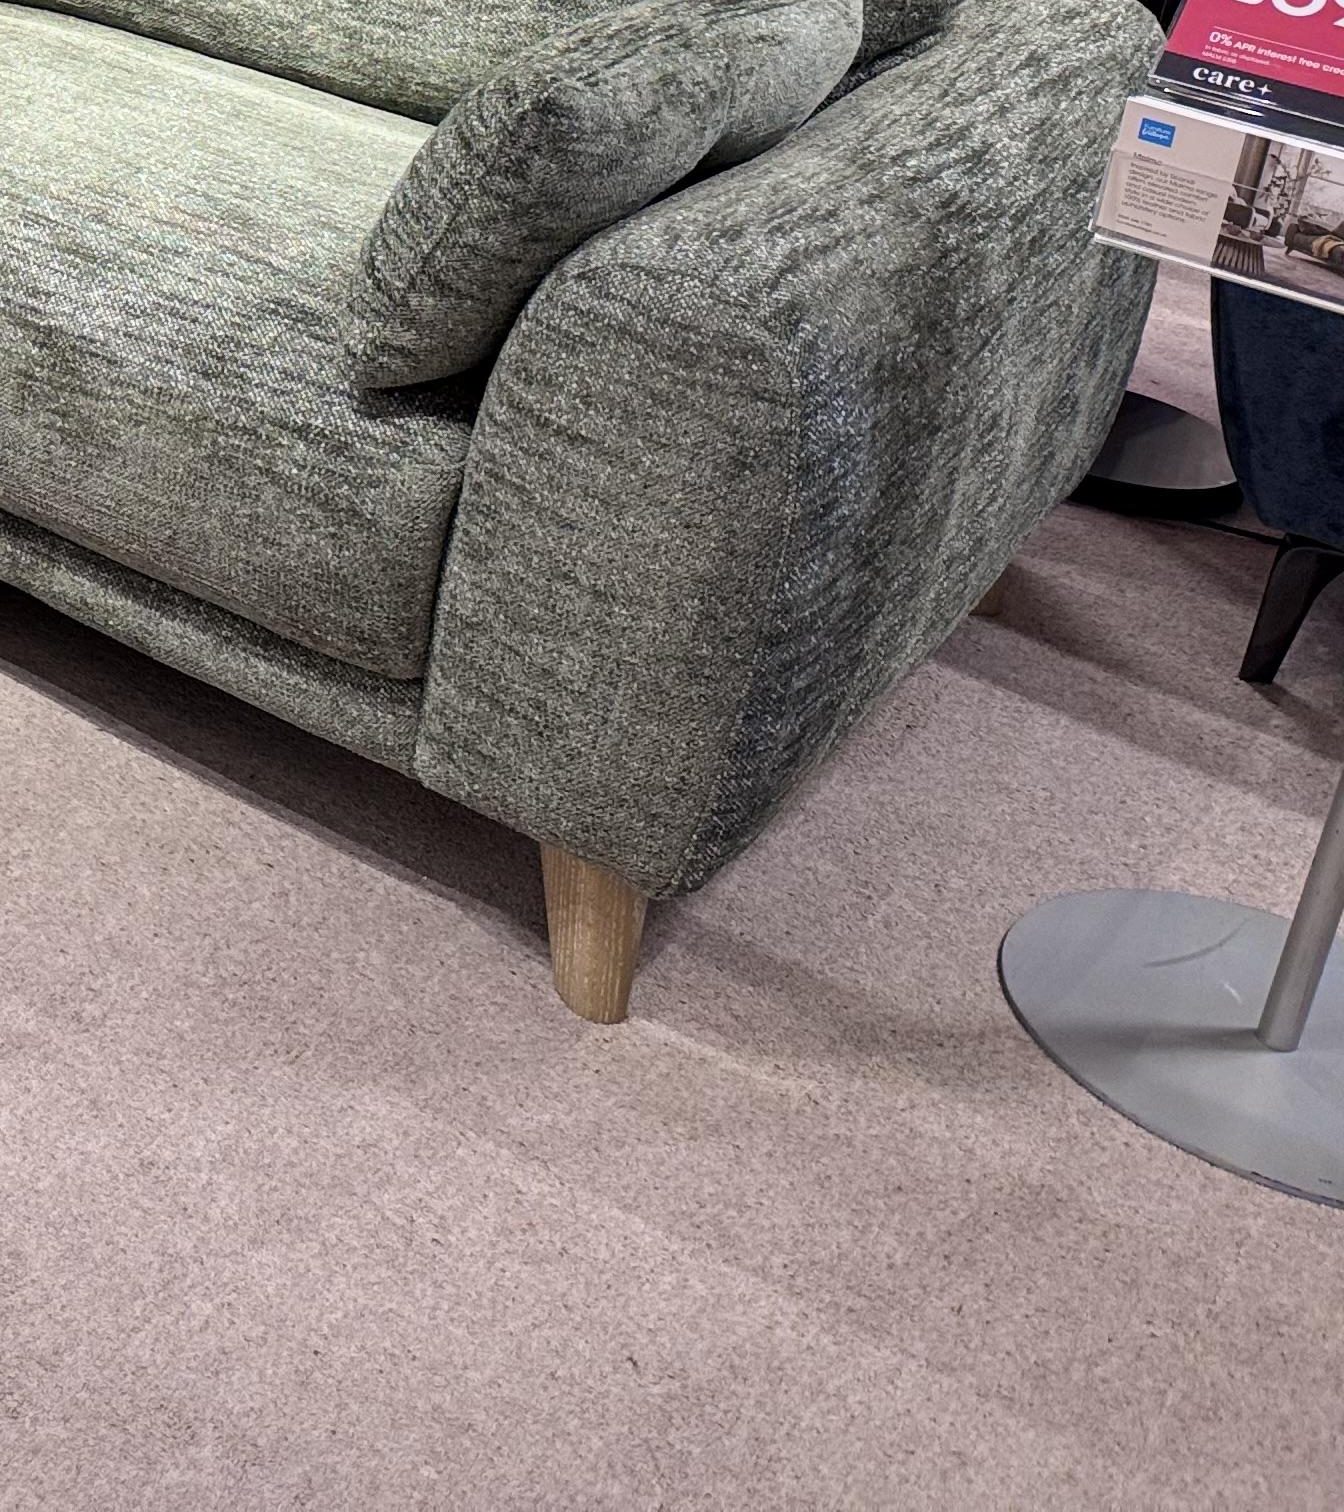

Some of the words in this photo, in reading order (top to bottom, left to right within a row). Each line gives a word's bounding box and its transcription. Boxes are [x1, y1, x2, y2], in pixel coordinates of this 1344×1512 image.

[1209, 31, 1232, 47] 0%
[1233, 40, 1256, 53] APR
[1257, 47, 1298, 63] interest
[1298, 57, 1321, 69] free
[1322, 64, 1344, 76] cre
